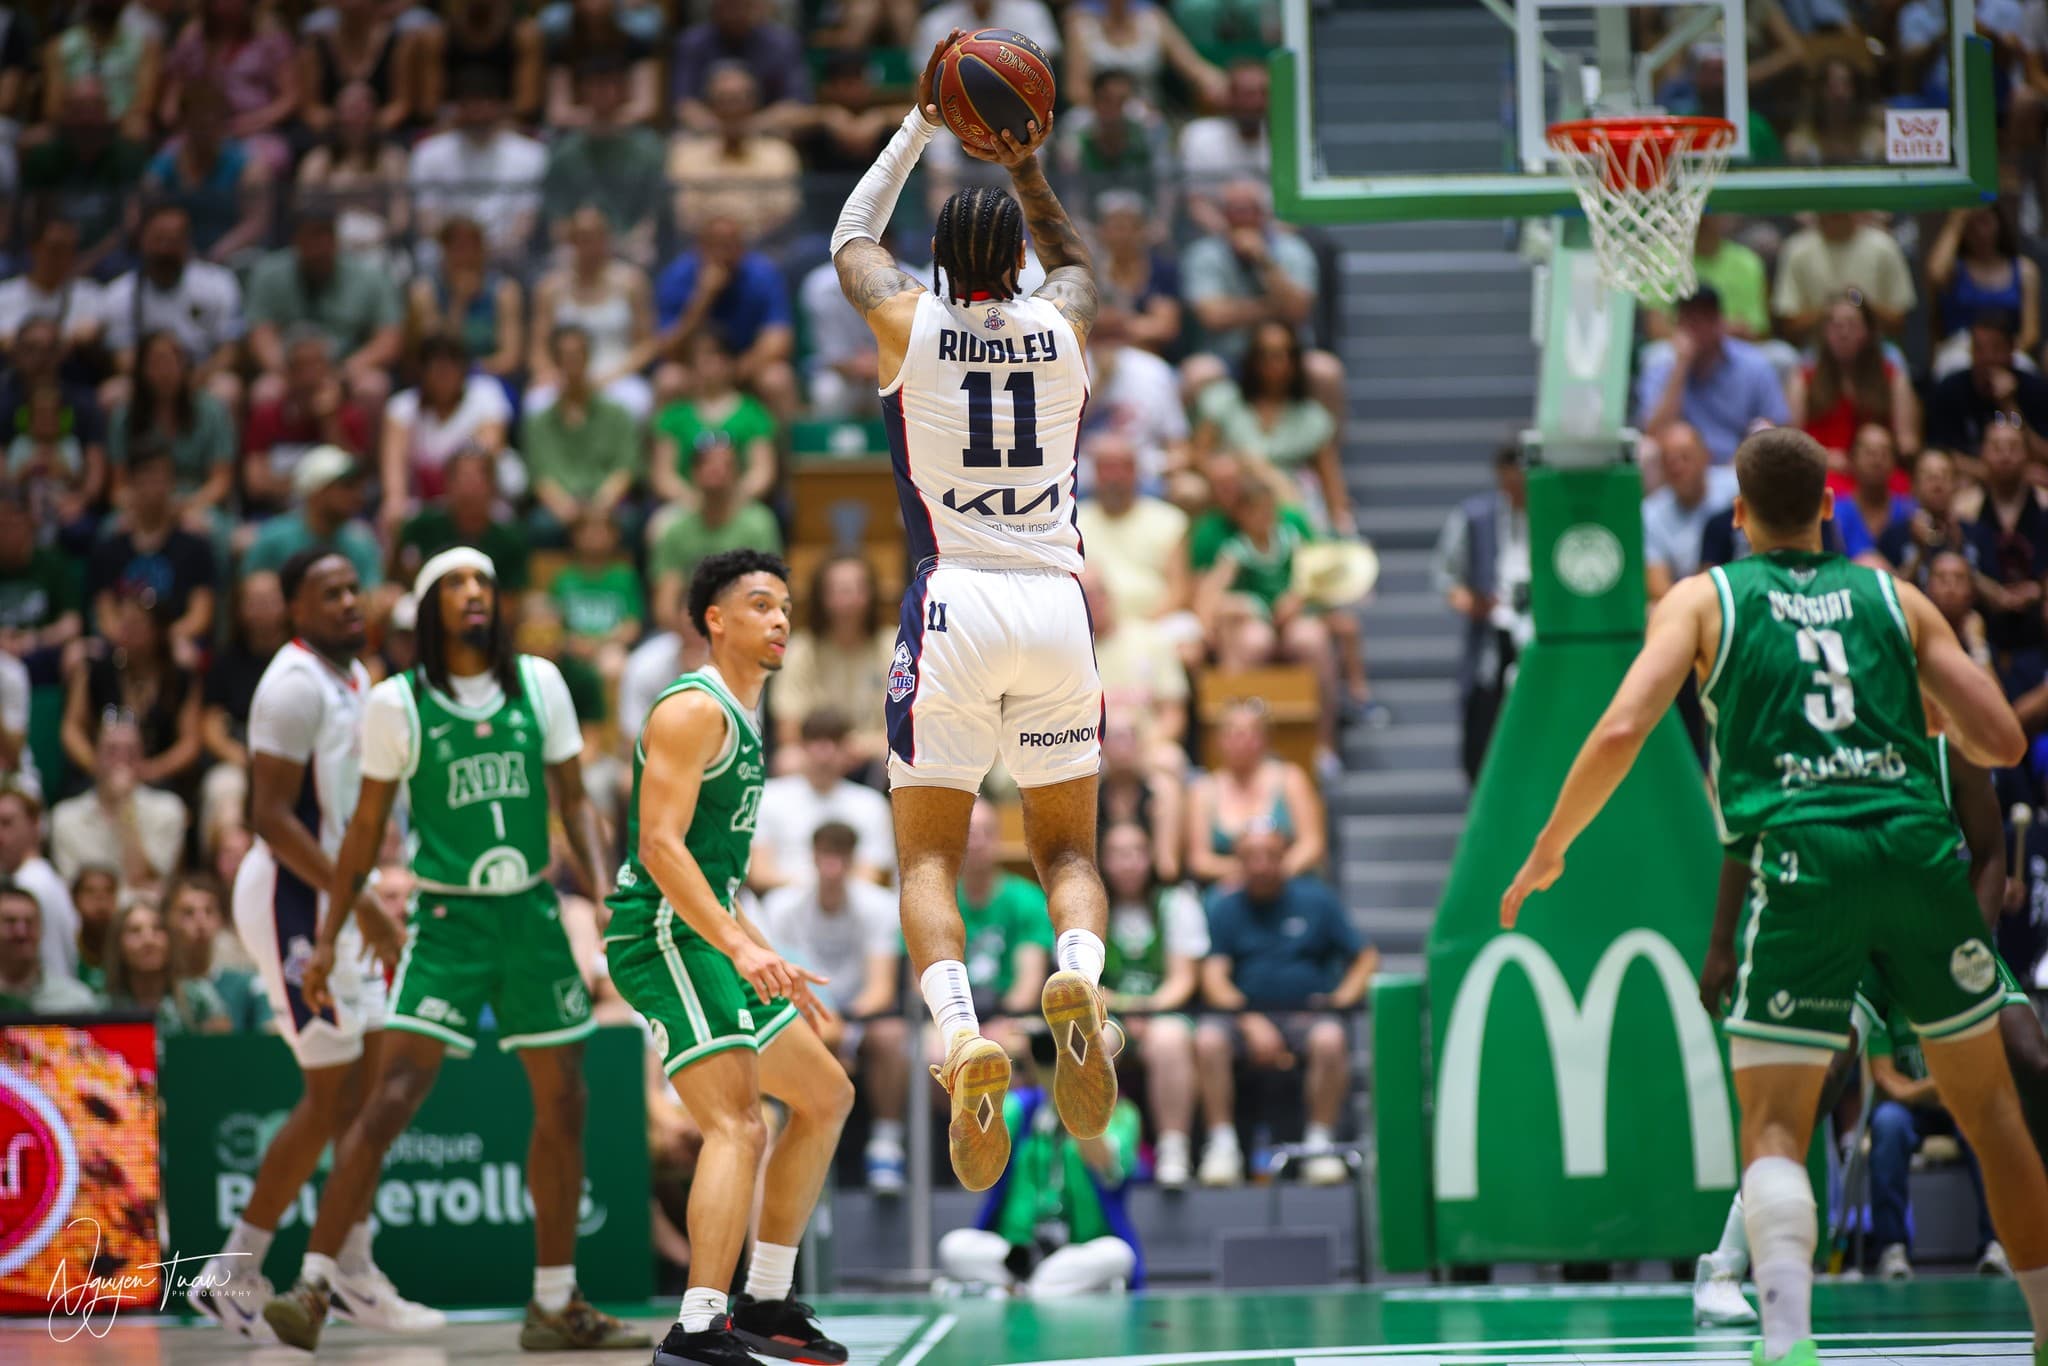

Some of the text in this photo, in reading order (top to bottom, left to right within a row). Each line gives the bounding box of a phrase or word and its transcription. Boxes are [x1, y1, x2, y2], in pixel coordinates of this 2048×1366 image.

[939, 328, 1058, 364] RIDDLEY
[960, 371, 1043, 468] 11
[927, 601, 948, 632] 11
[1796, 625, 1857, 732] 3
[448, 751, 530, 810] ADA
[489, 801, 507, 840] 1
[1779, 851, 1799, 883] 3
[382, 1125, 484, 1171] ptique
